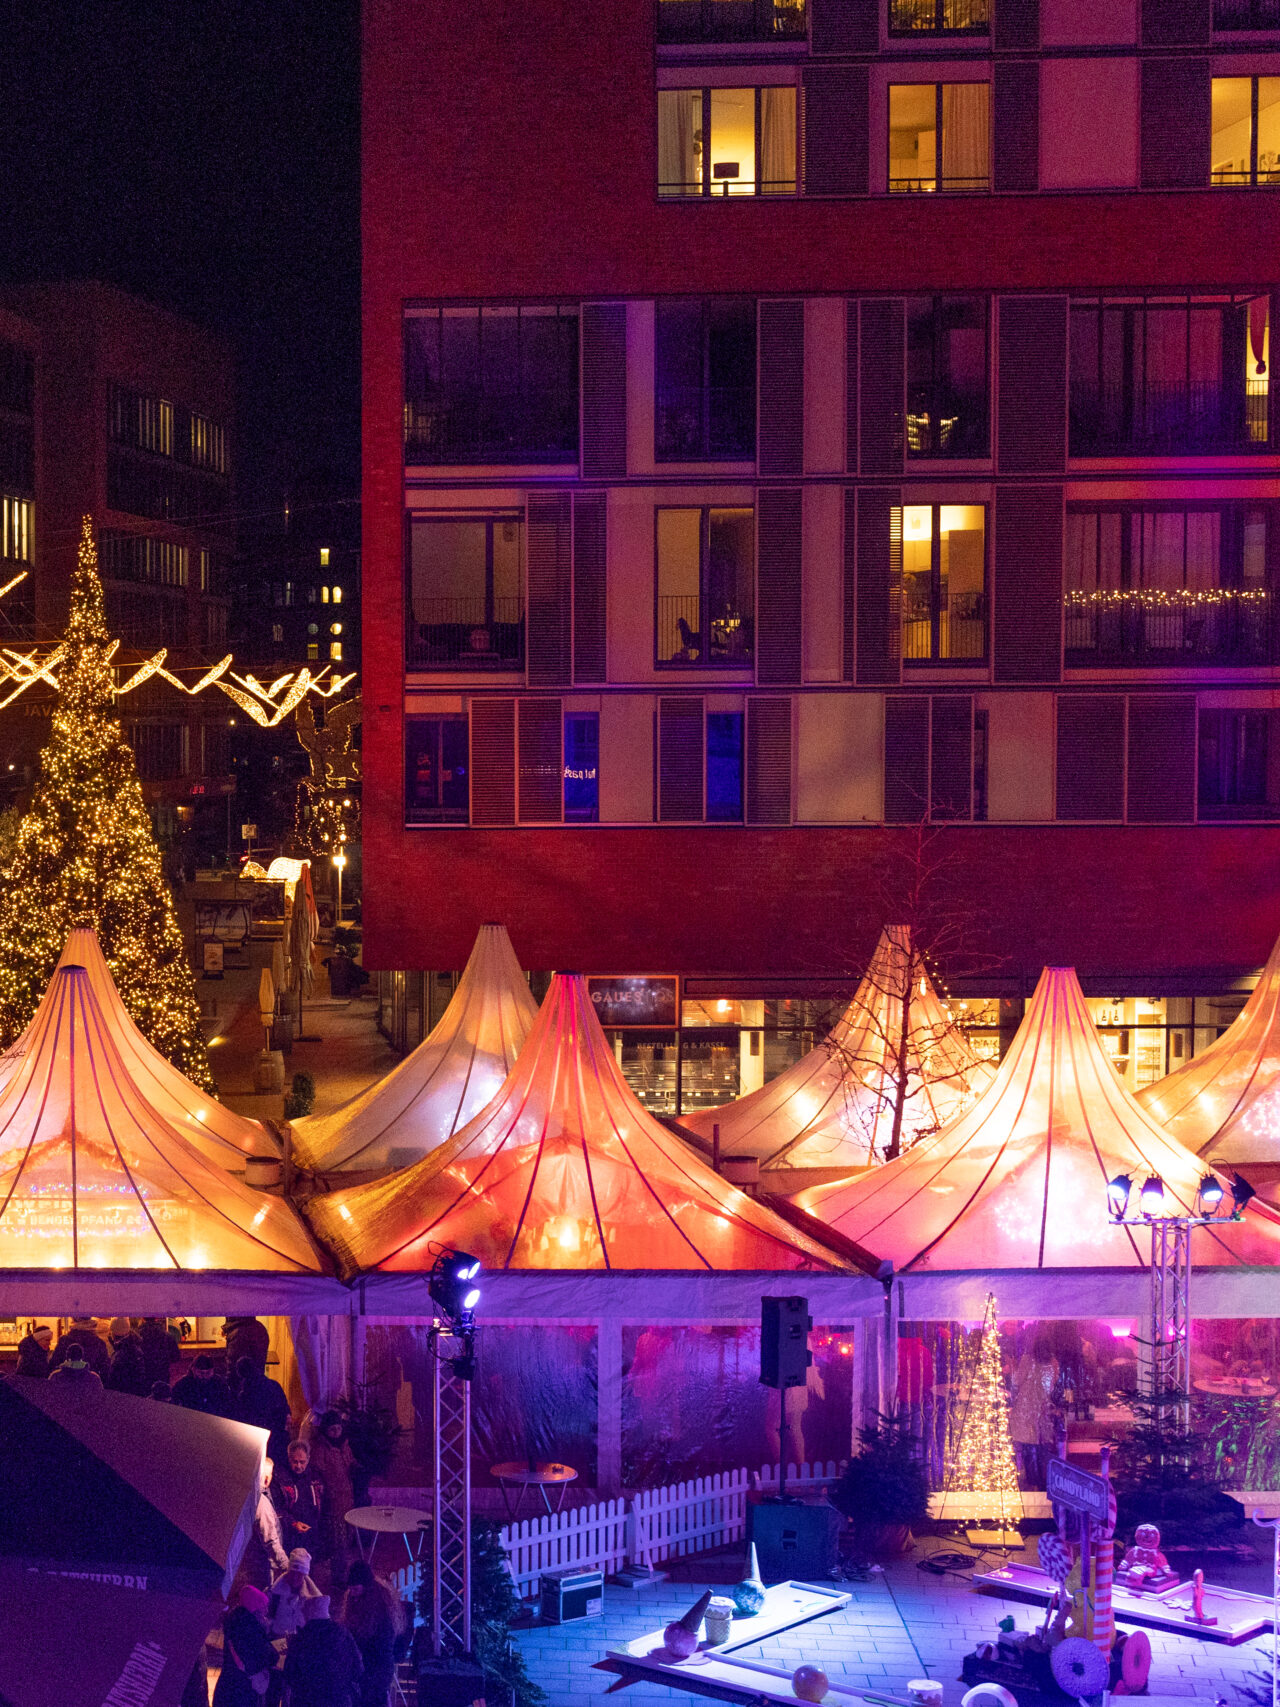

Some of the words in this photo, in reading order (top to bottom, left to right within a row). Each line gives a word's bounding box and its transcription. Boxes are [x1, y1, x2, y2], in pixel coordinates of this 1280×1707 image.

[29, 1214, 74, 1226] BENGE
[1054, 1473, 1101, 1508] CANDYLAND
[100, 1642, 168, 1707] ATSHERRN
